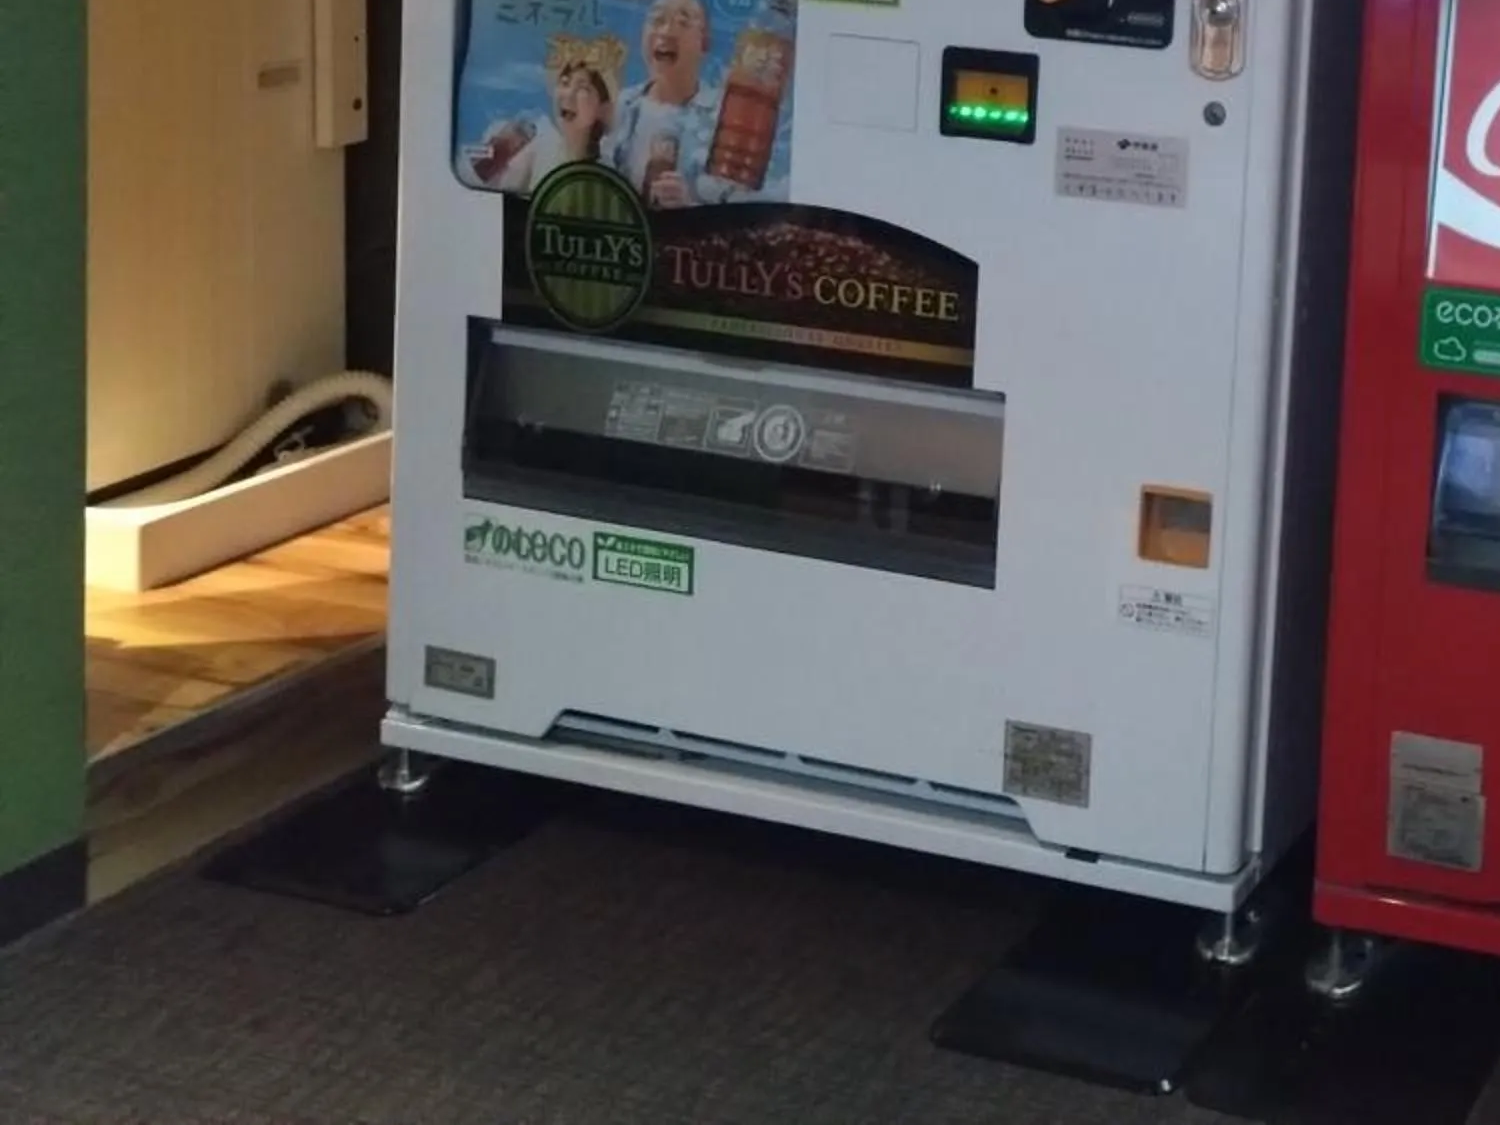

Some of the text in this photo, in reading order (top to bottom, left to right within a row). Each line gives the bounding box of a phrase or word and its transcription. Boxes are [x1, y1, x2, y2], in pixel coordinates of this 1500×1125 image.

[535, 223, 643, 268] TULLY'S
[665, 245, 960, 322] TULLY'S COFFEE
[604, 555, 683, 589] LED照明
